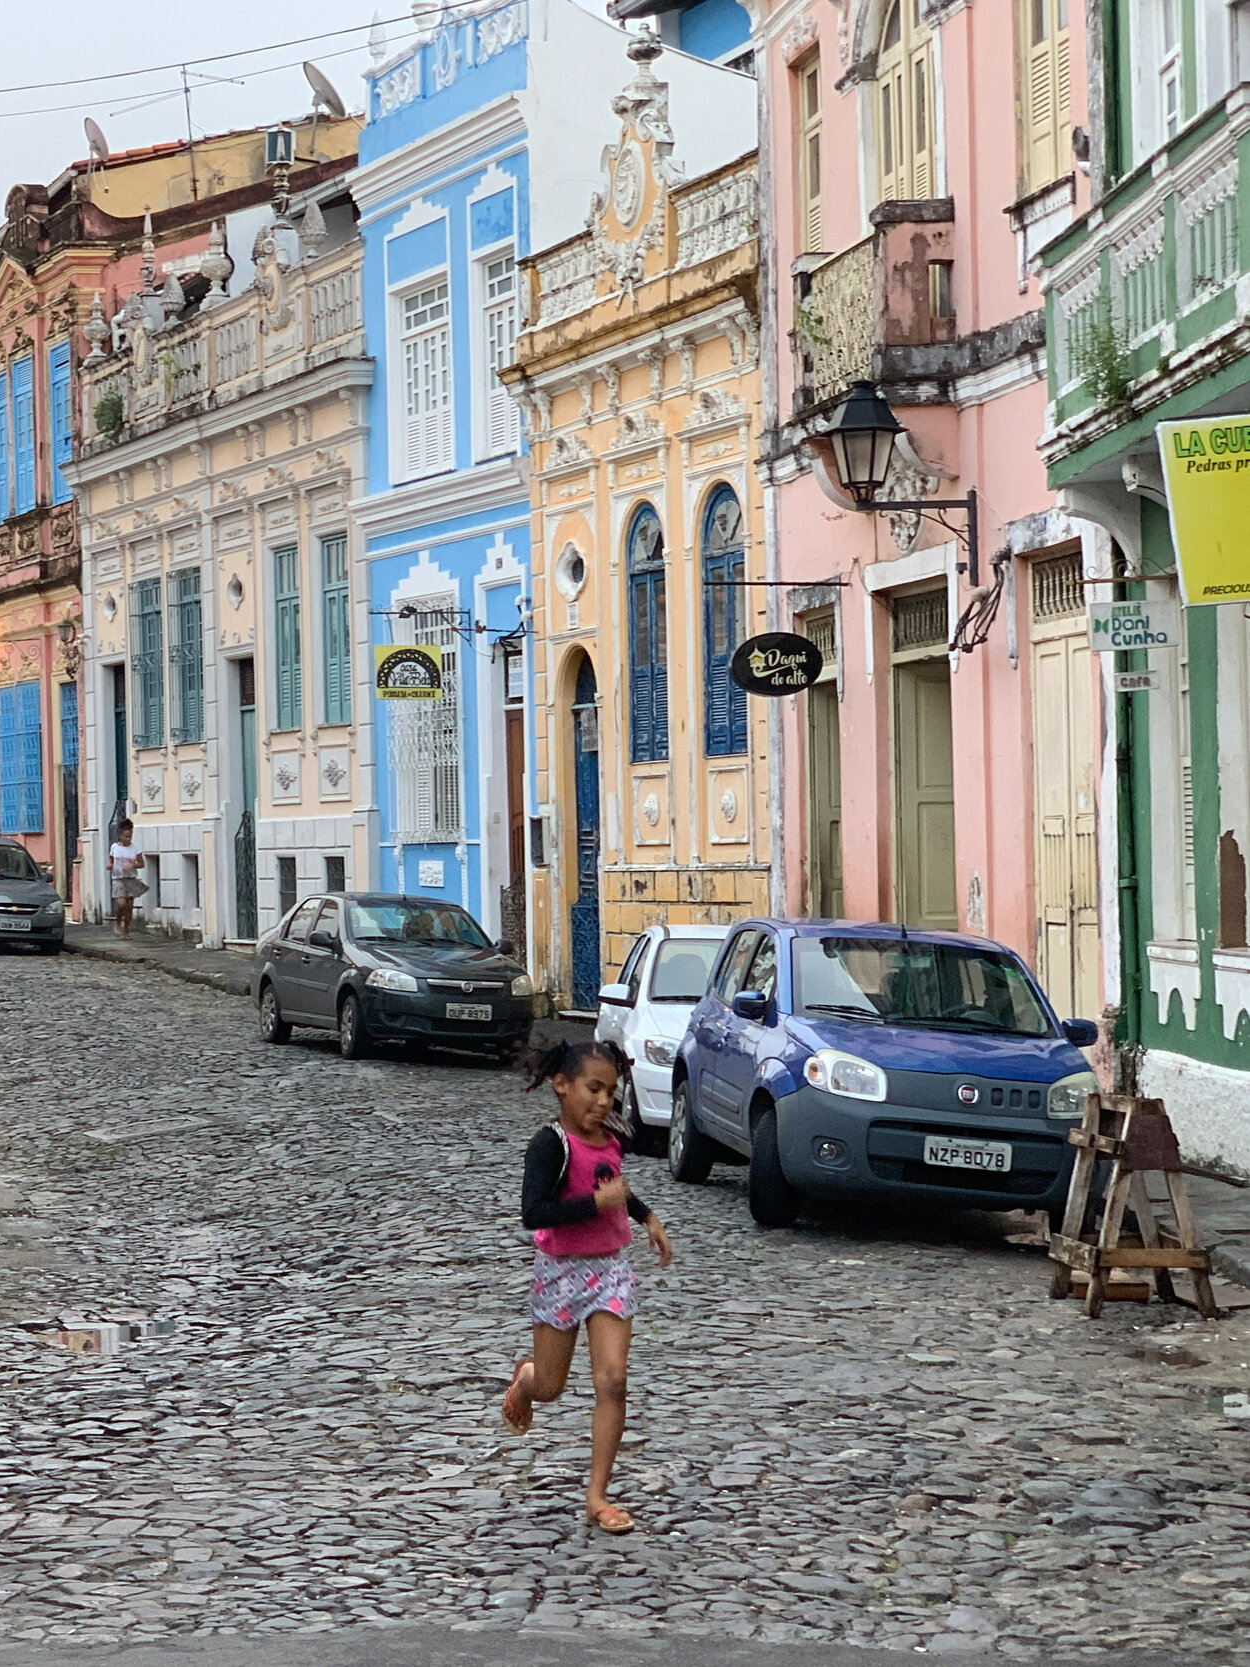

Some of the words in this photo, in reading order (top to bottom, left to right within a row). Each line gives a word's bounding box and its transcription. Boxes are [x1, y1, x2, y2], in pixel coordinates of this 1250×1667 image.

[1173, 430, 1207, 458] LA
[1186, 458, 1233, 474] Pedras
[1112, 616, 1150, 632] Dani
[1111, 630, 1168, 646] Cunha
[764, 648, 807, 671] Daqui
